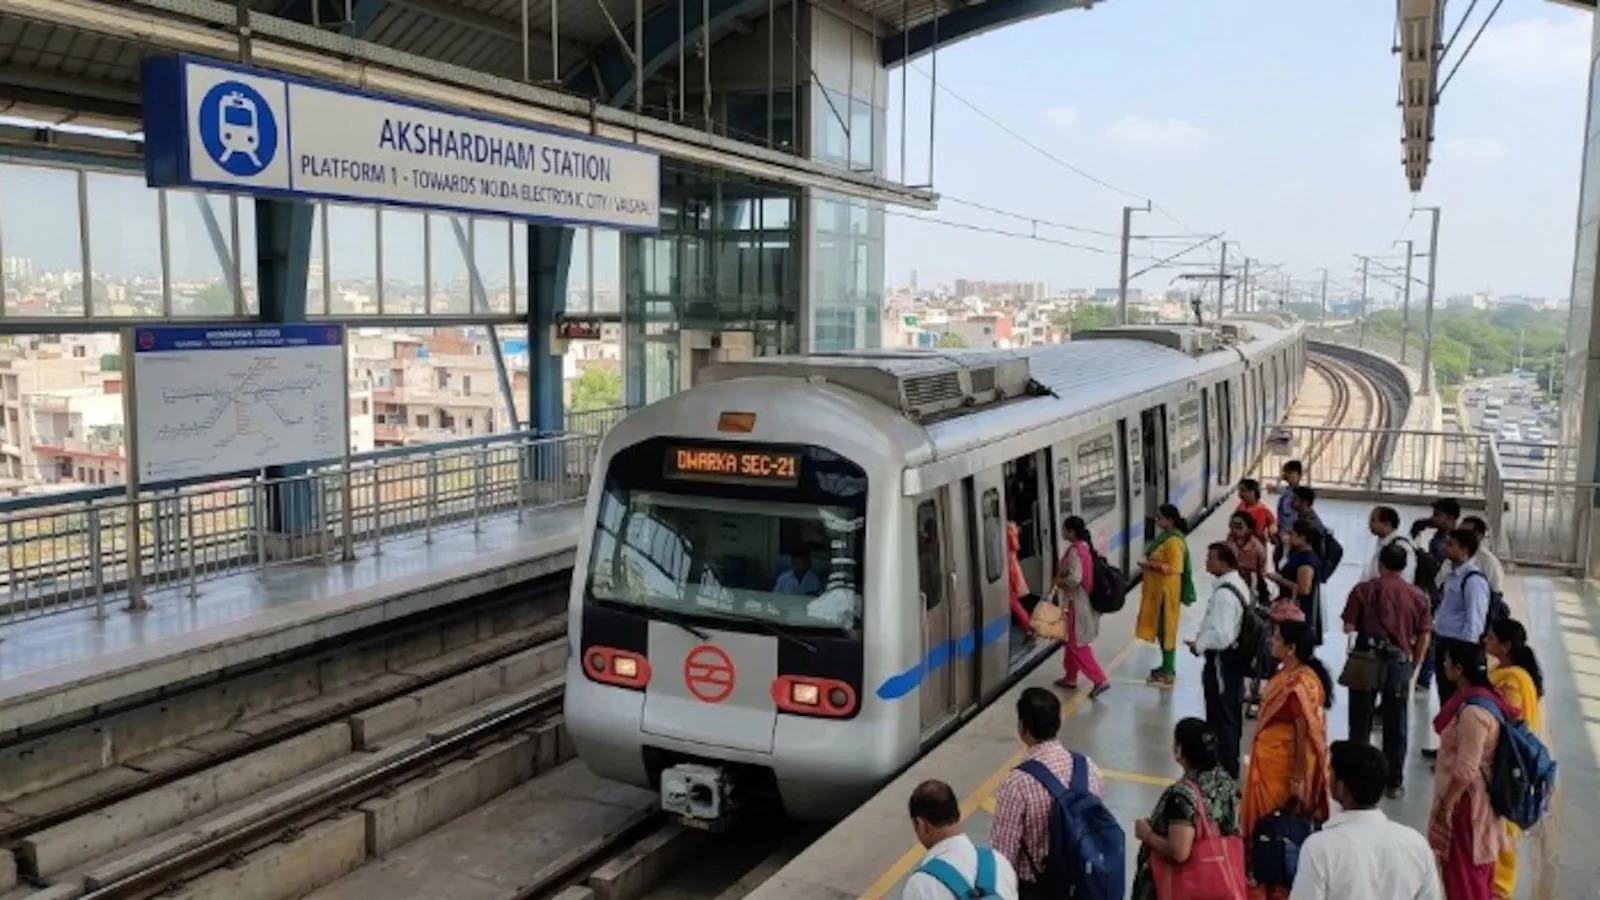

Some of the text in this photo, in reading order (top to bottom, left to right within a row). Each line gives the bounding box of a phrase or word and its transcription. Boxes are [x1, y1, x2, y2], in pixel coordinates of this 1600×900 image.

[379, 118, 610, 184] AKSHARDHAM STATION
[301, 155, 385, 184] PLATFORM
[391, 166, 397, 186] 1
[412, 169, 476, 195] TOWARDS
[677, 450, 796, 477] DWARKA SEC-21
